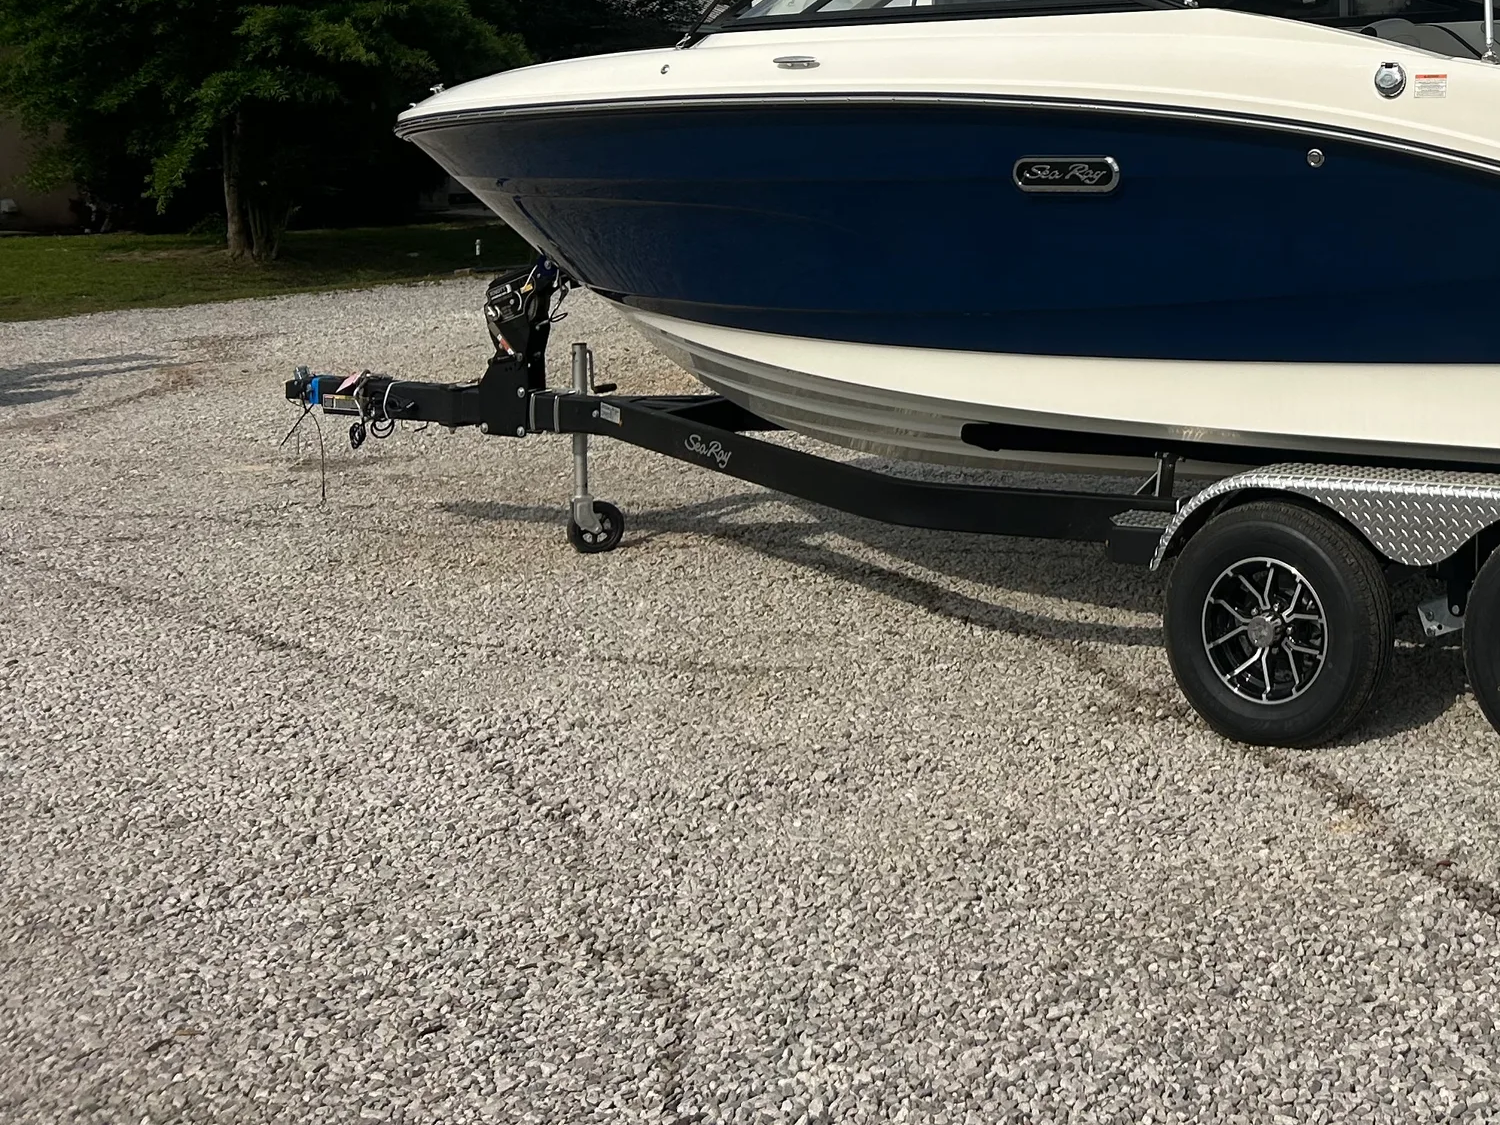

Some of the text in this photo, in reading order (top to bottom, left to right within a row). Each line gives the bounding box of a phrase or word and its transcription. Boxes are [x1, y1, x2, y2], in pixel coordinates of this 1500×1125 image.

[1023, 163, 1107, 184] Sea Ray
[684, 434, 732, 468] Sea Ray
